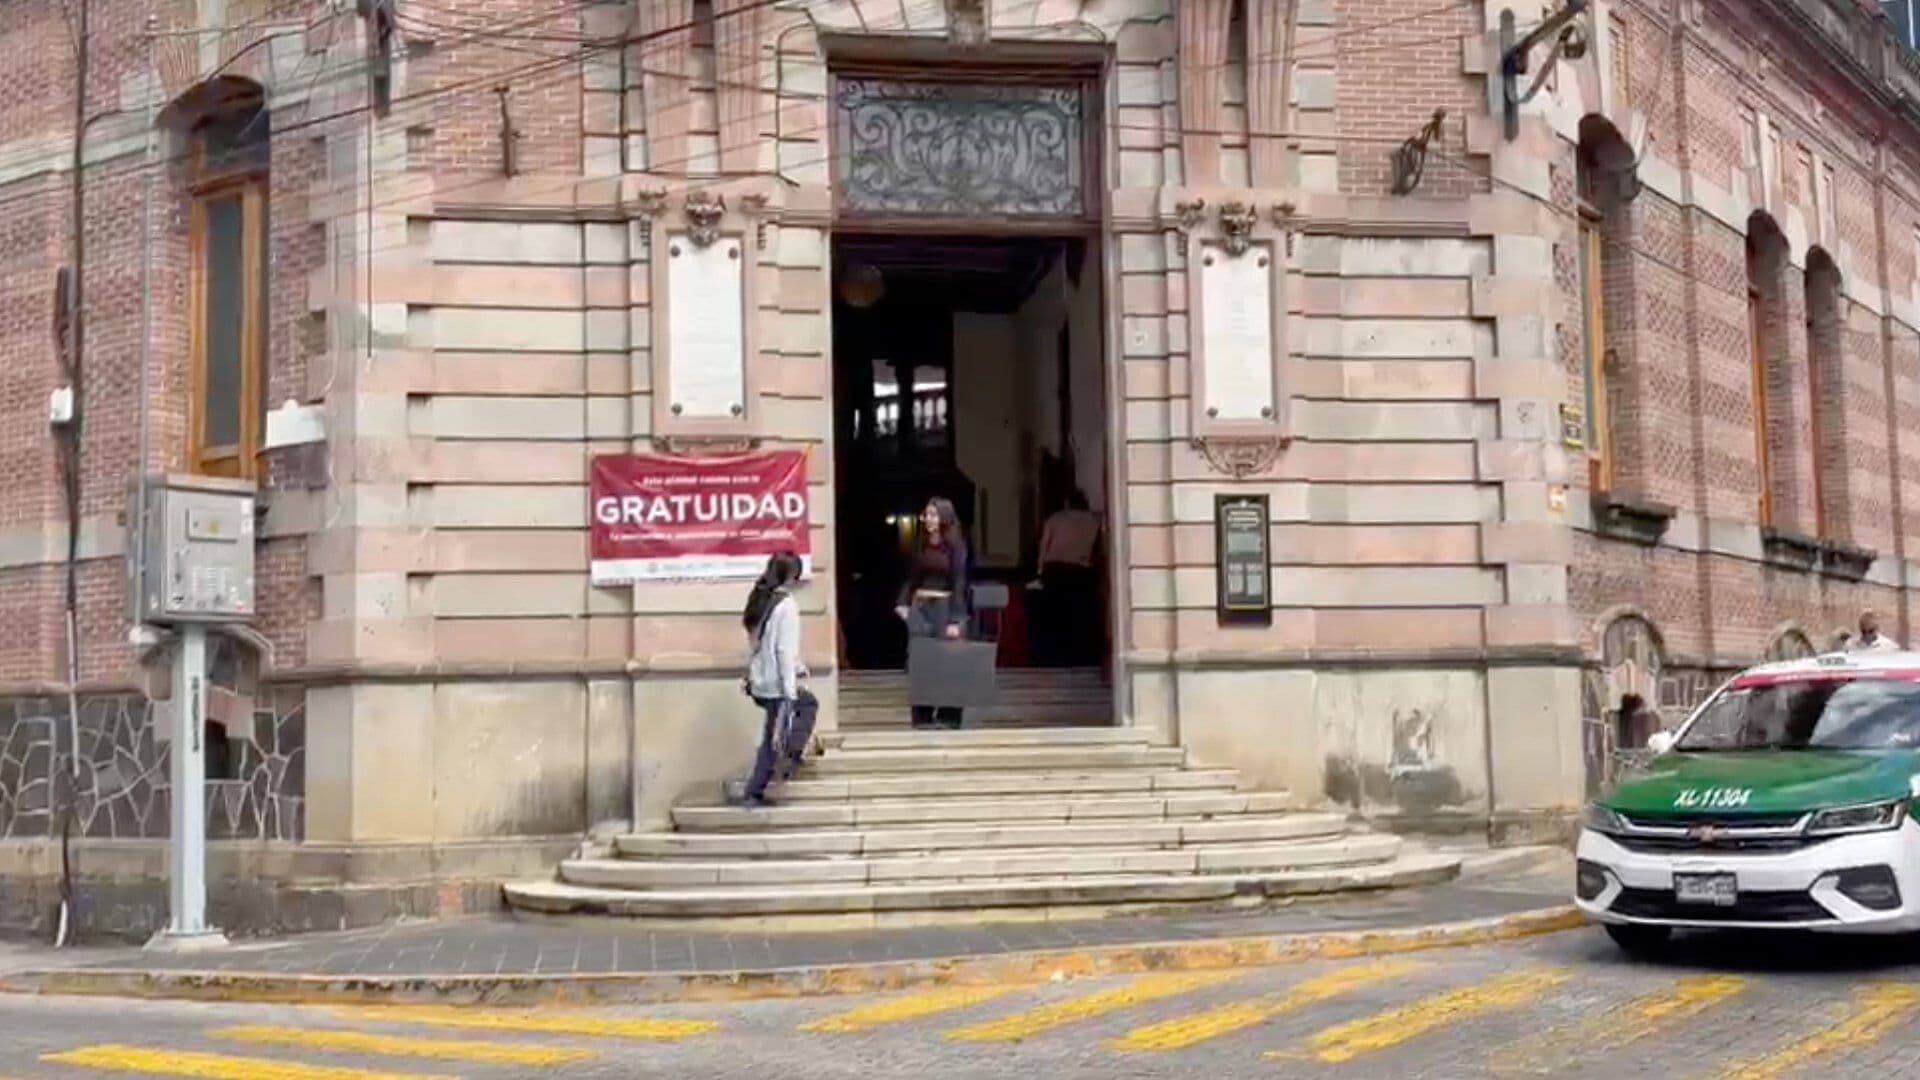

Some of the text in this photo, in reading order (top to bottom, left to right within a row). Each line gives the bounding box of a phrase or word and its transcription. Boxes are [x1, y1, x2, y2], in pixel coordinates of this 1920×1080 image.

[596, 492, 805, 523] GRATUIDAD
[1673, 787, 1751, 807] XL 11304
